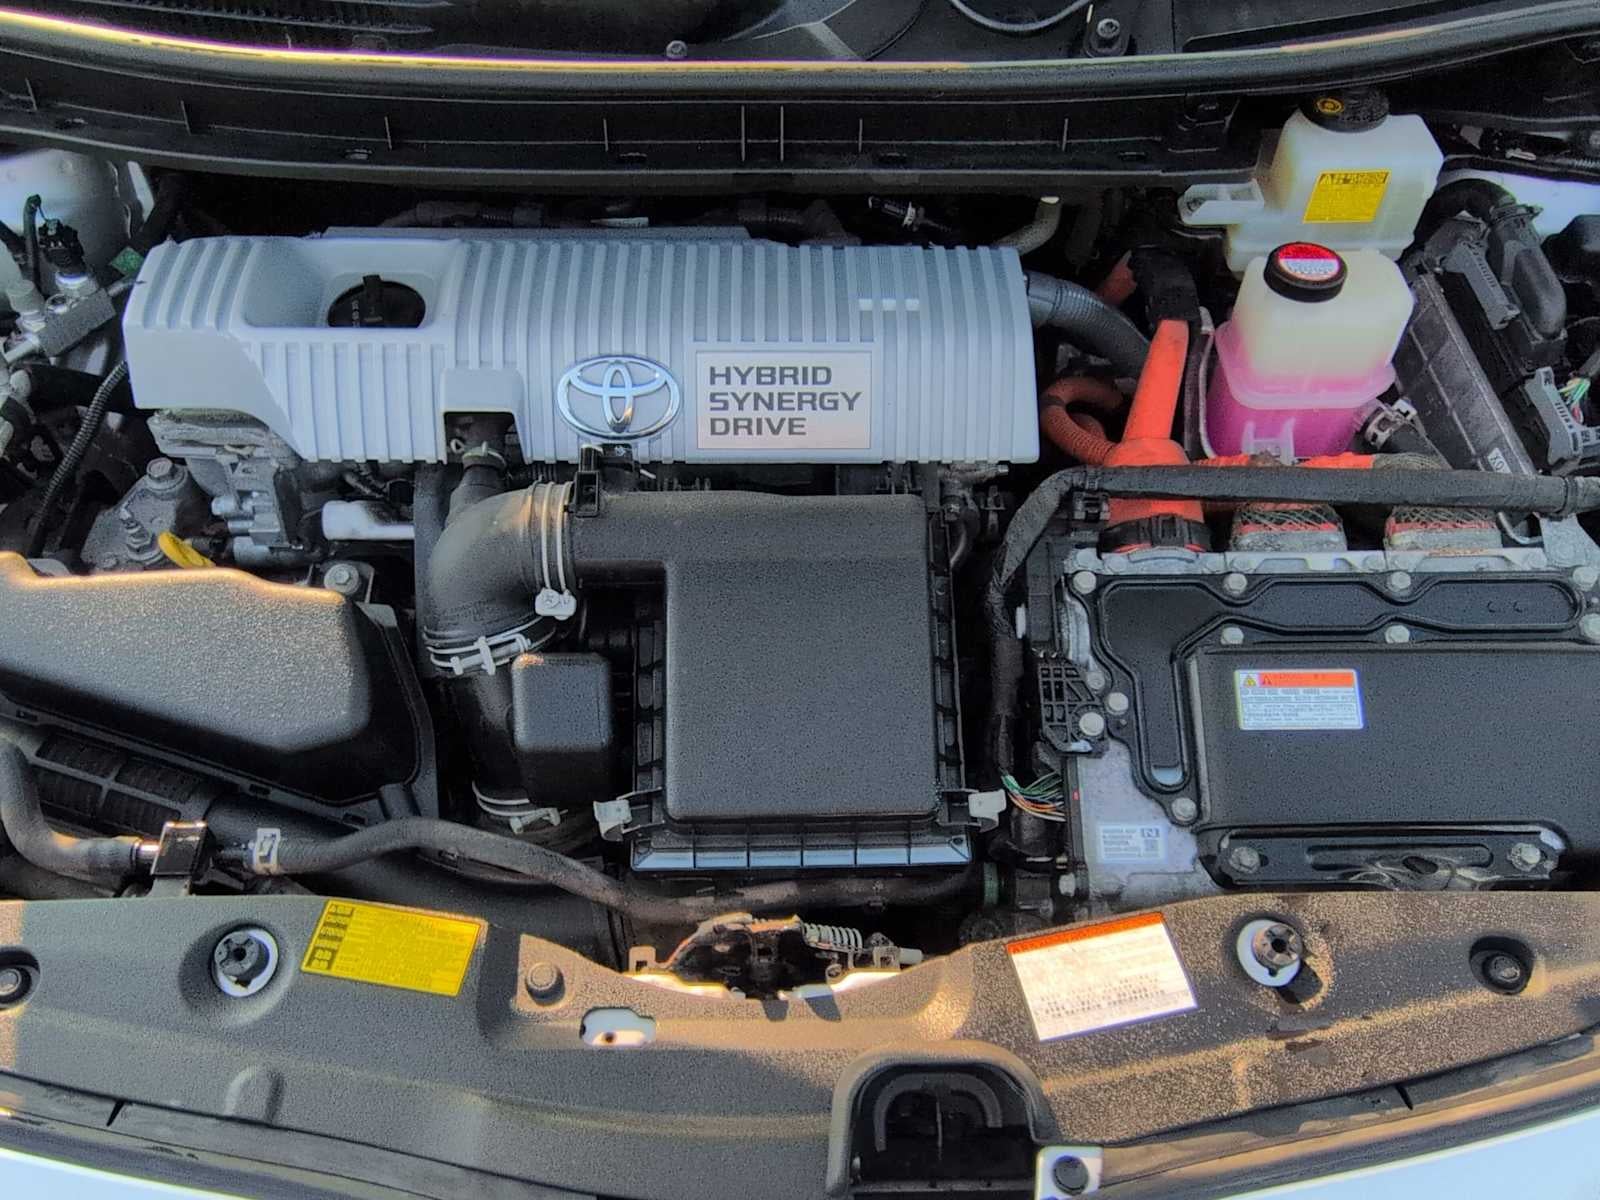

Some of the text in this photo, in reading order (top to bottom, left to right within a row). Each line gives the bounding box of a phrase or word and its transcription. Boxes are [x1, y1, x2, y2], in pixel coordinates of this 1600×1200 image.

[709, 366, 832, 385] HYBRID
[709, 391, 862, 411] SYNERGY
[709, 417, 807, 435] DRIVE
